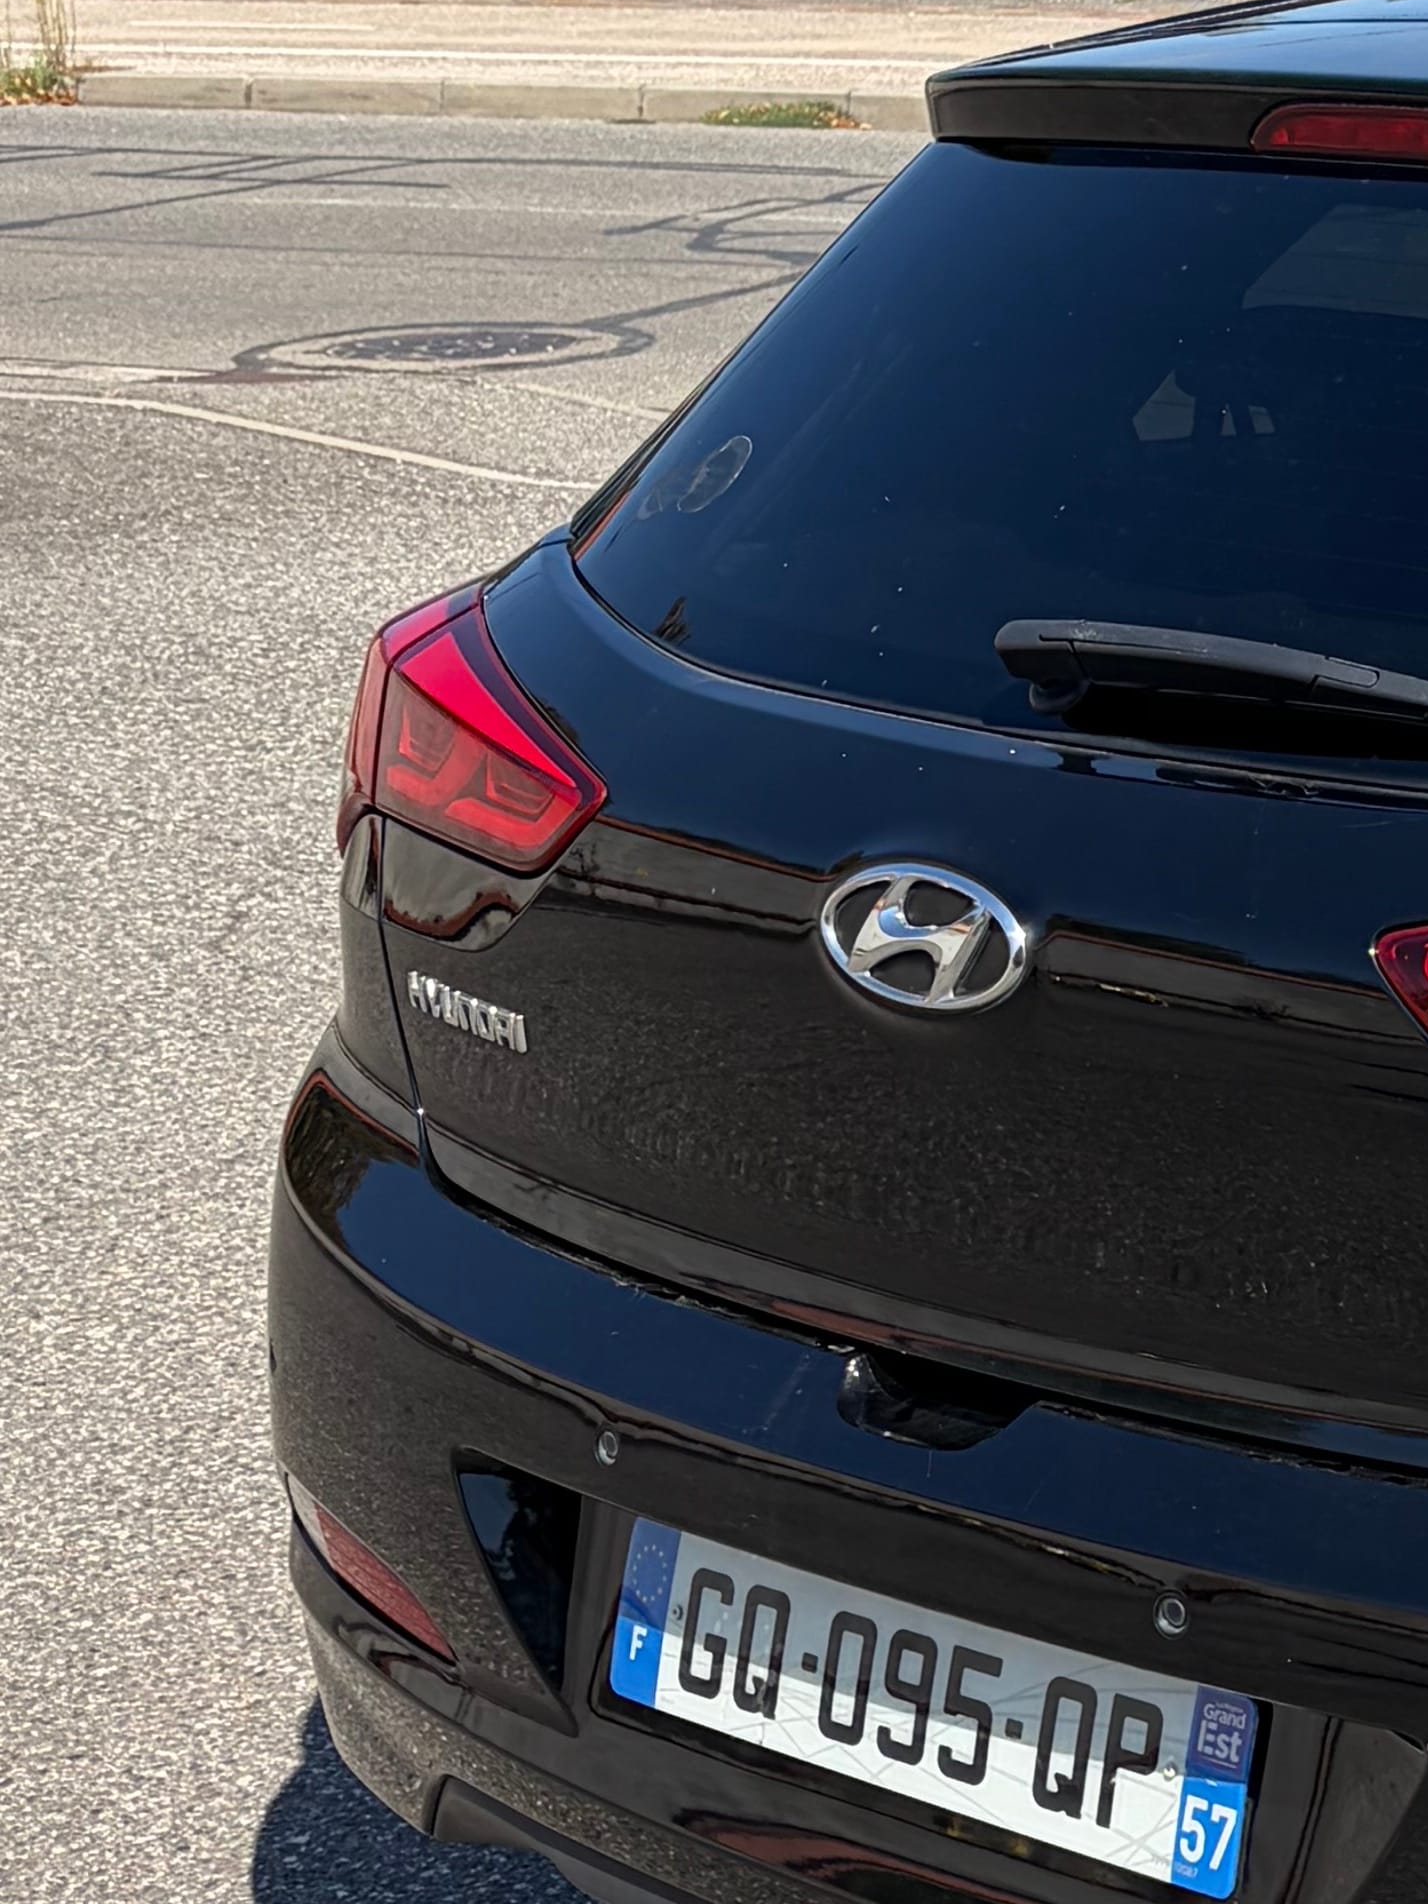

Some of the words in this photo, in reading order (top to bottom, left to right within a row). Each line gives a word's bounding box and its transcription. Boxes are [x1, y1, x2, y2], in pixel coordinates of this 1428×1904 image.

[408, 971, 528, 1053] HYUNDAI
[628, 1627, 648, 1663] F
[677, 1567, 1163, 1828] GQ-095-QP
[1203, 1703, 1247, 1730] Grand
[1197, 1720, 1242, 1763] Est
[1179, 1794, 1238, 1871] 57
